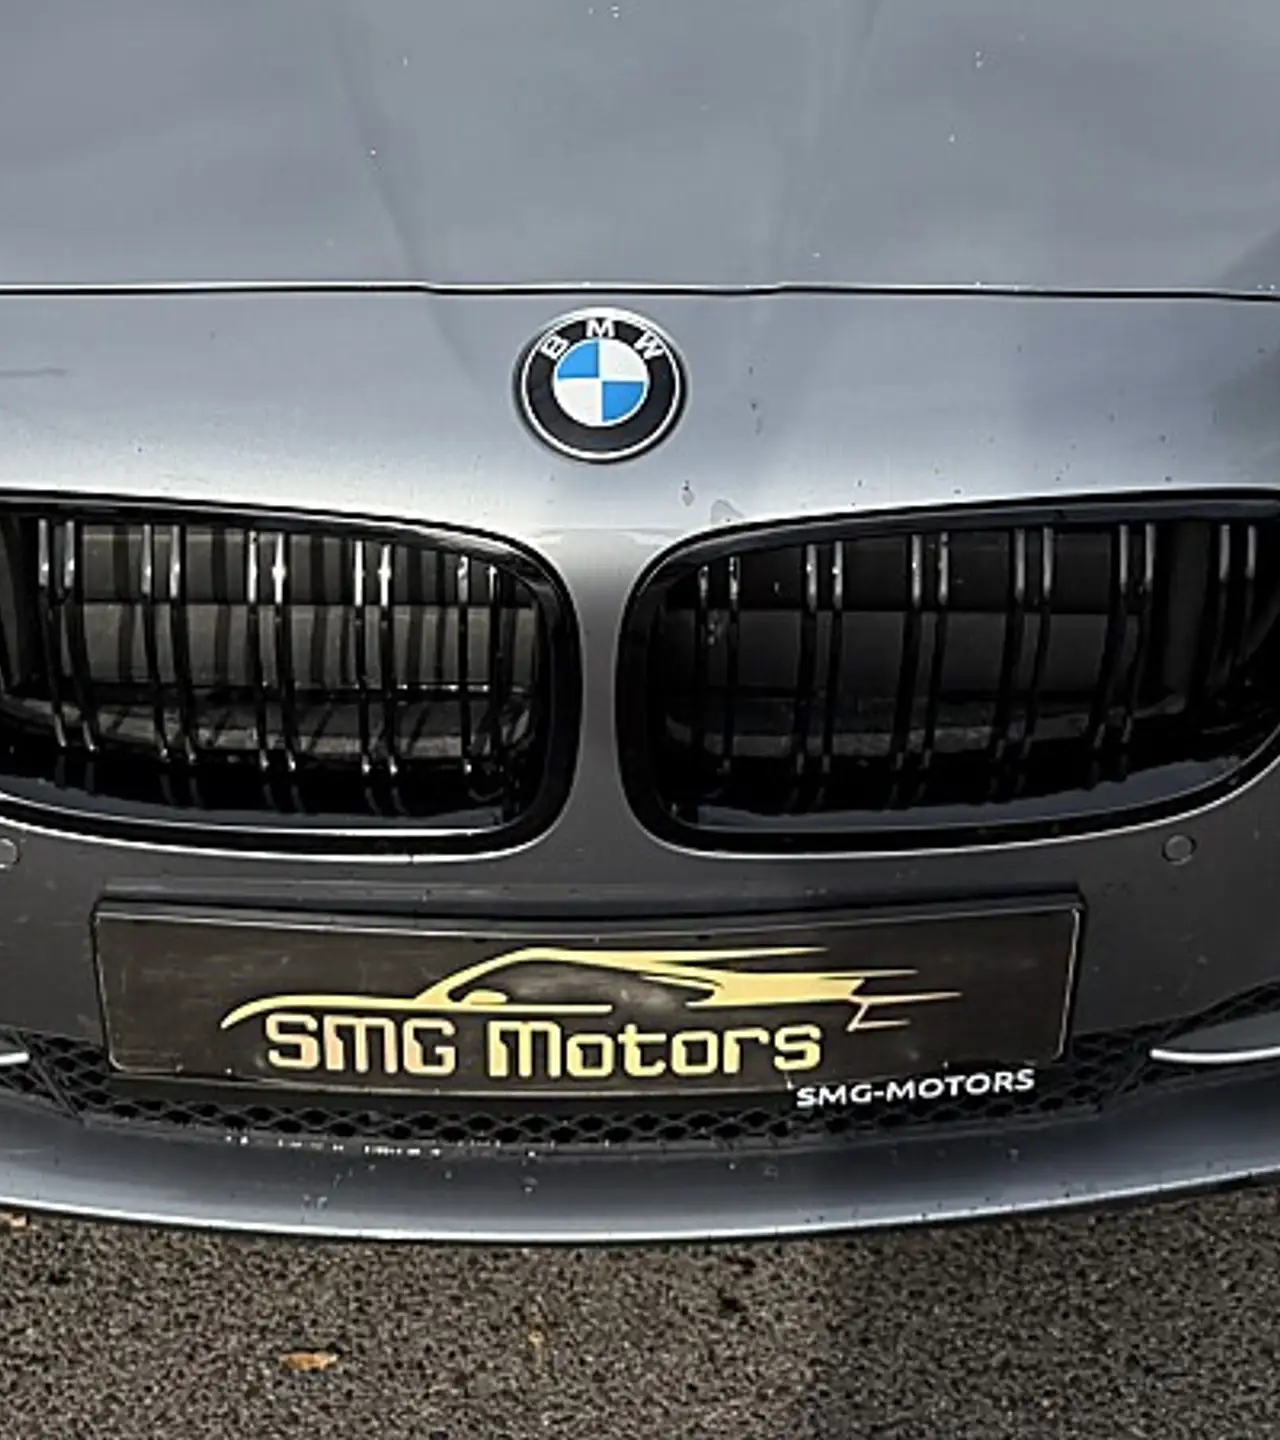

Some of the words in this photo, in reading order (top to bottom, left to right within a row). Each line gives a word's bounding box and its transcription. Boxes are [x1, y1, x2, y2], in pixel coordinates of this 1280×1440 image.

[541, 319, 664, 360] BMW
[265, 1013, 456, 1075] SMG
[487, 1020, 822, 1078] Motors
[796, 1068, 1035, 1109] SMG-MOTORS
